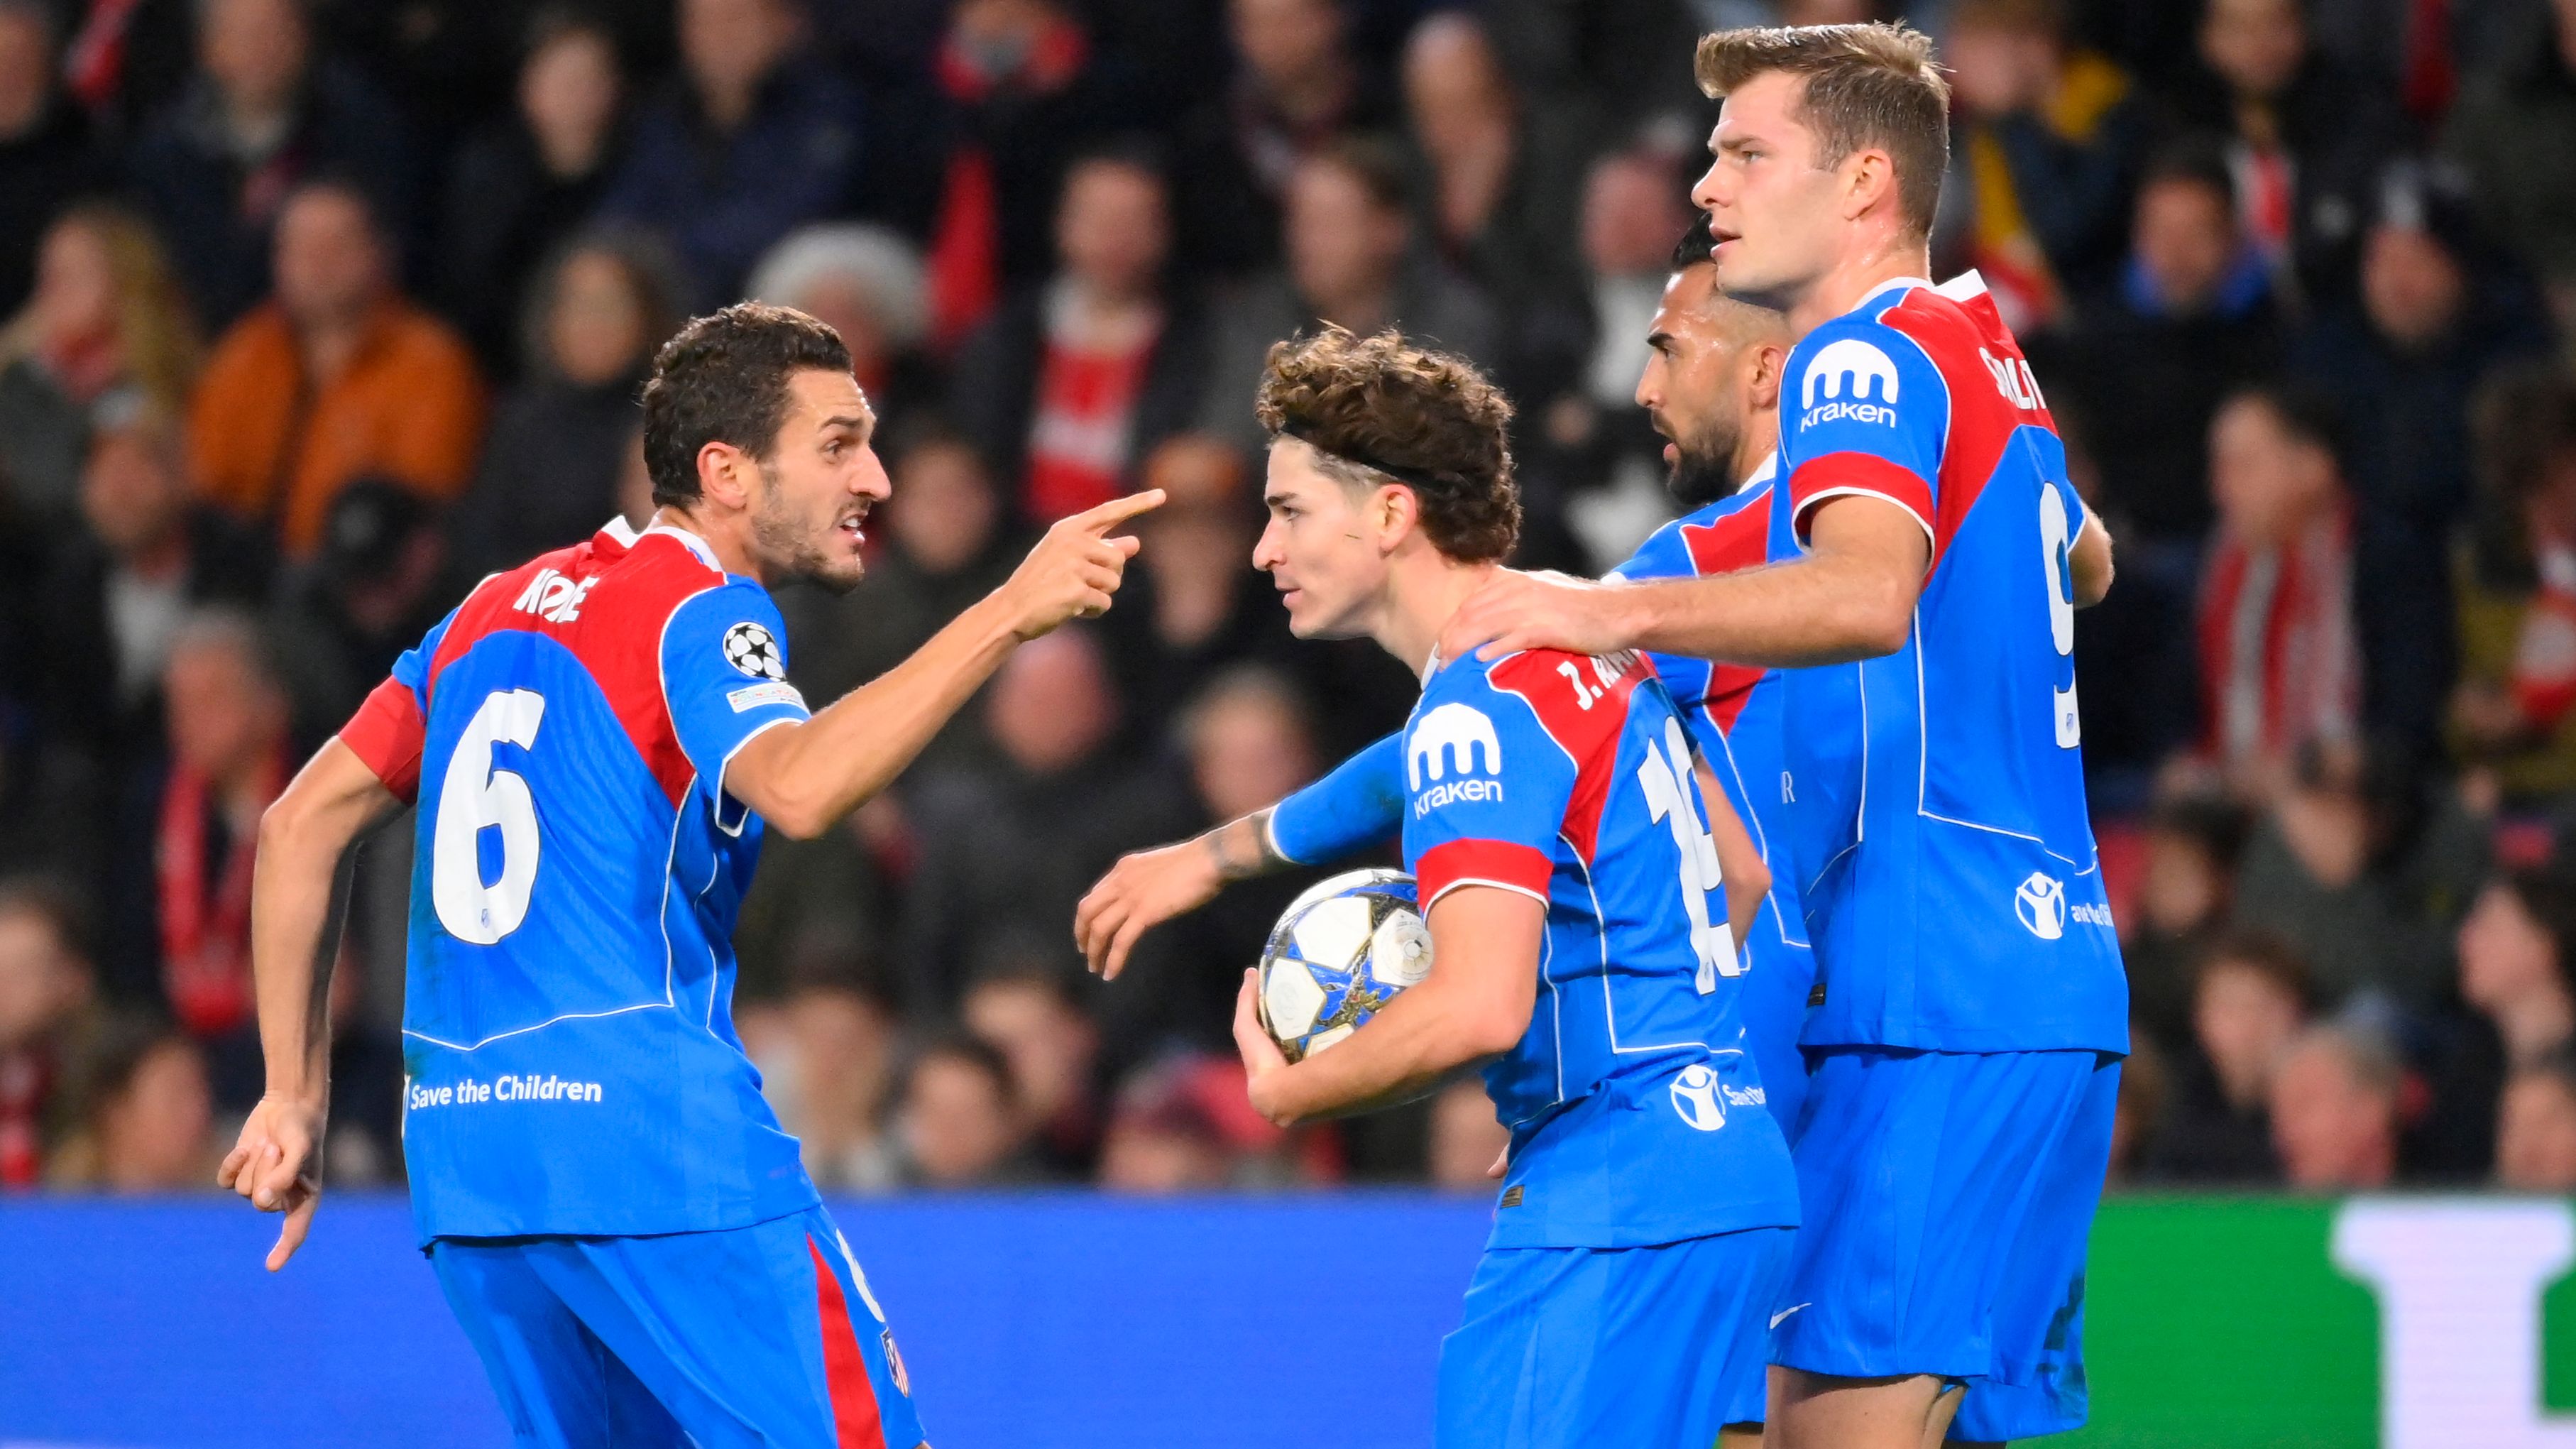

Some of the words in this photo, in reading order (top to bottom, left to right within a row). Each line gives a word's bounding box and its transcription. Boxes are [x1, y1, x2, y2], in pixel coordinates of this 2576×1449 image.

[1800, 402, 1896, 433] kraken
[2039, 481, 2081, 750] 9
[432, 687, 545, 945] 6
[1413, 779, 1503, 821] kraken
[1637, 716, 1741, 995] 19
[410, 1084, 452, 1110] Save
[456, 1078, 490, 1104] the
[495, 1074, 603, 1102] Children
